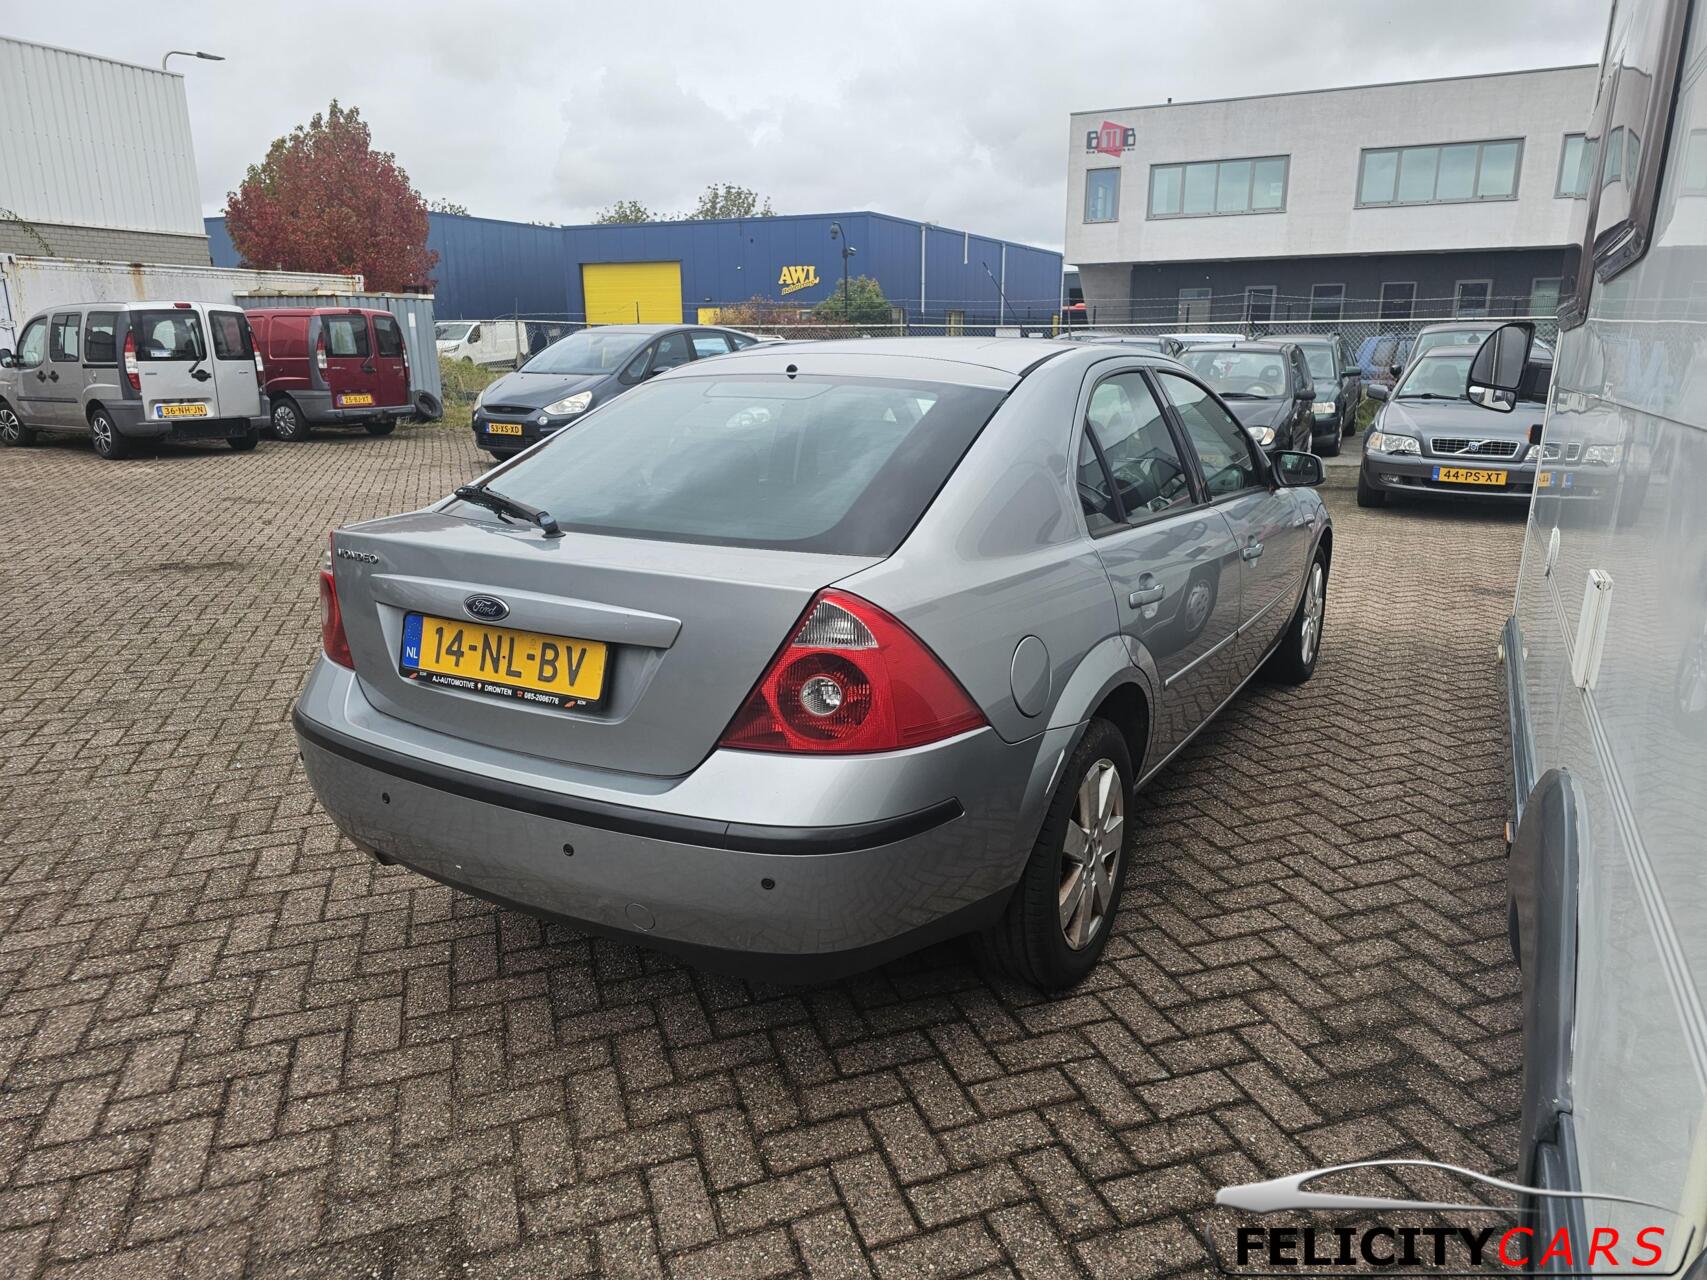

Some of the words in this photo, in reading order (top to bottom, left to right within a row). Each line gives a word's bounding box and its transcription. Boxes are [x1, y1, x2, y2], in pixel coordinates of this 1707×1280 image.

[778, 266, 819, 285] AWL
[164, 405, 204, 415] 36-NH-JN
[490, 424, 520, 434] 53-XS-XD
[1443, 470, 1502, 483] 44-PS-XT
[406, 646, 418, 659] NL
[435, 626, 587, 688] 14-NL-BV
[432, 675, 476, 689] AJ-AUTOMOTIVE
[484, 684, 512, 696] DRONTEN
